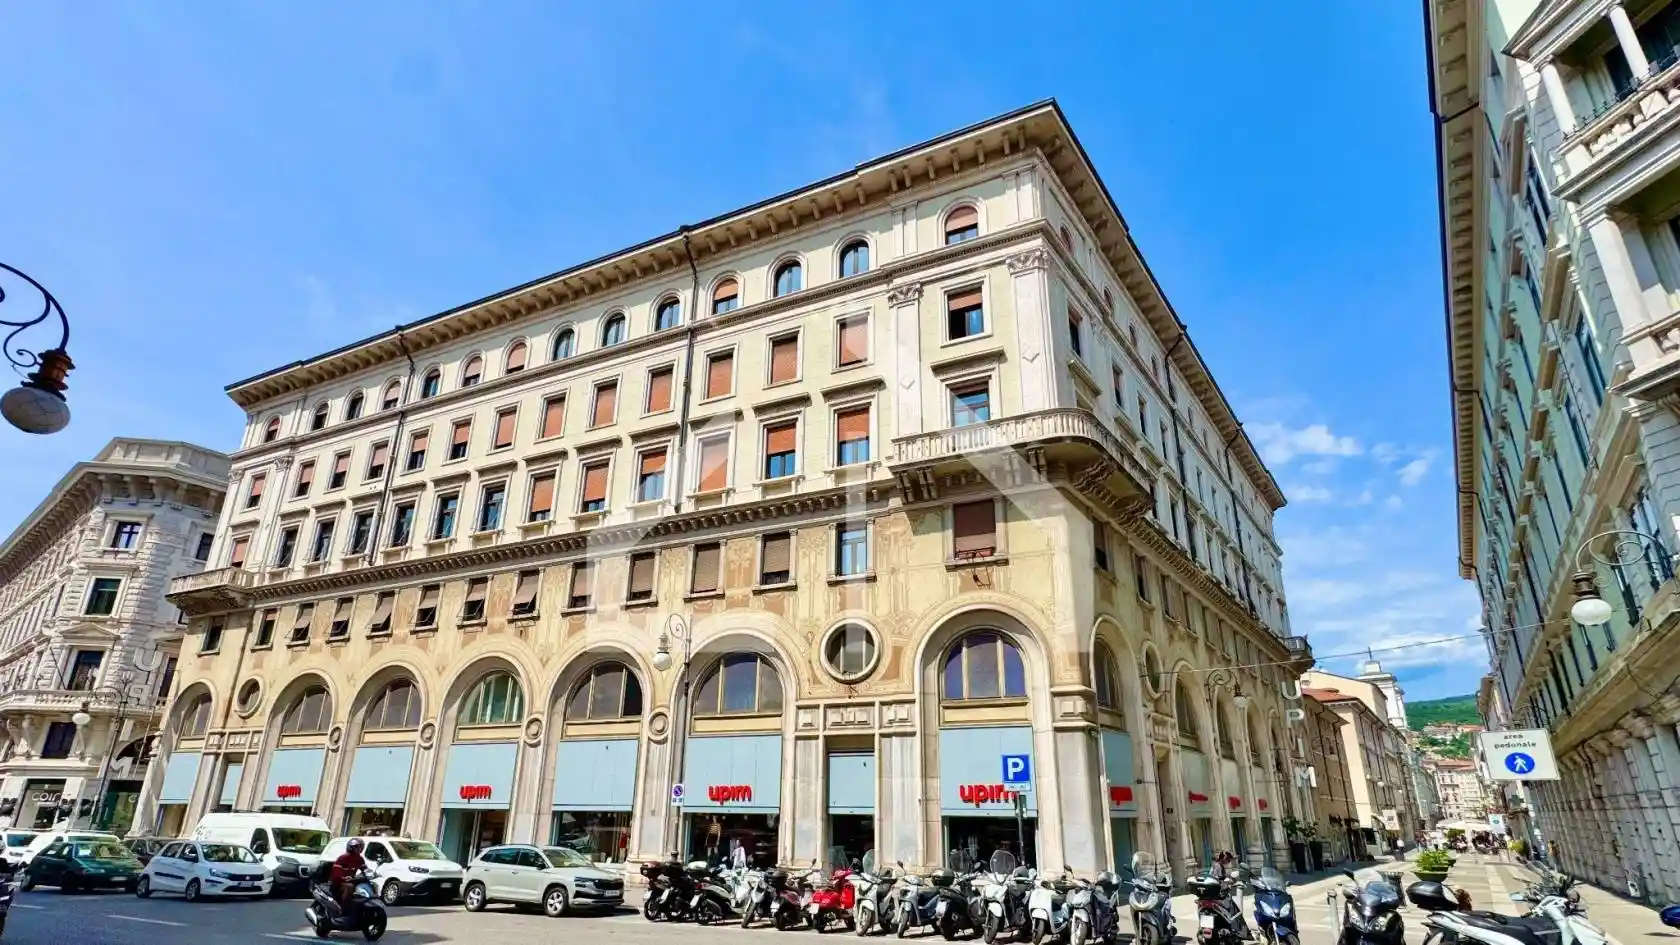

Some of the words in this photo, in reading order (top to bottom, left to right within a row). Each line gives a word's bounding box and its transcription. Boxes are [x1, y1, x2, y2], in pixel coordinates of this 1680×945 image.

[1281, 680, 1317, 787] UPIM
[1494, 741, 1536, 749] pedonale
[1007, 757, 1024, 780] P
[708, 785, 752, 805] upim
